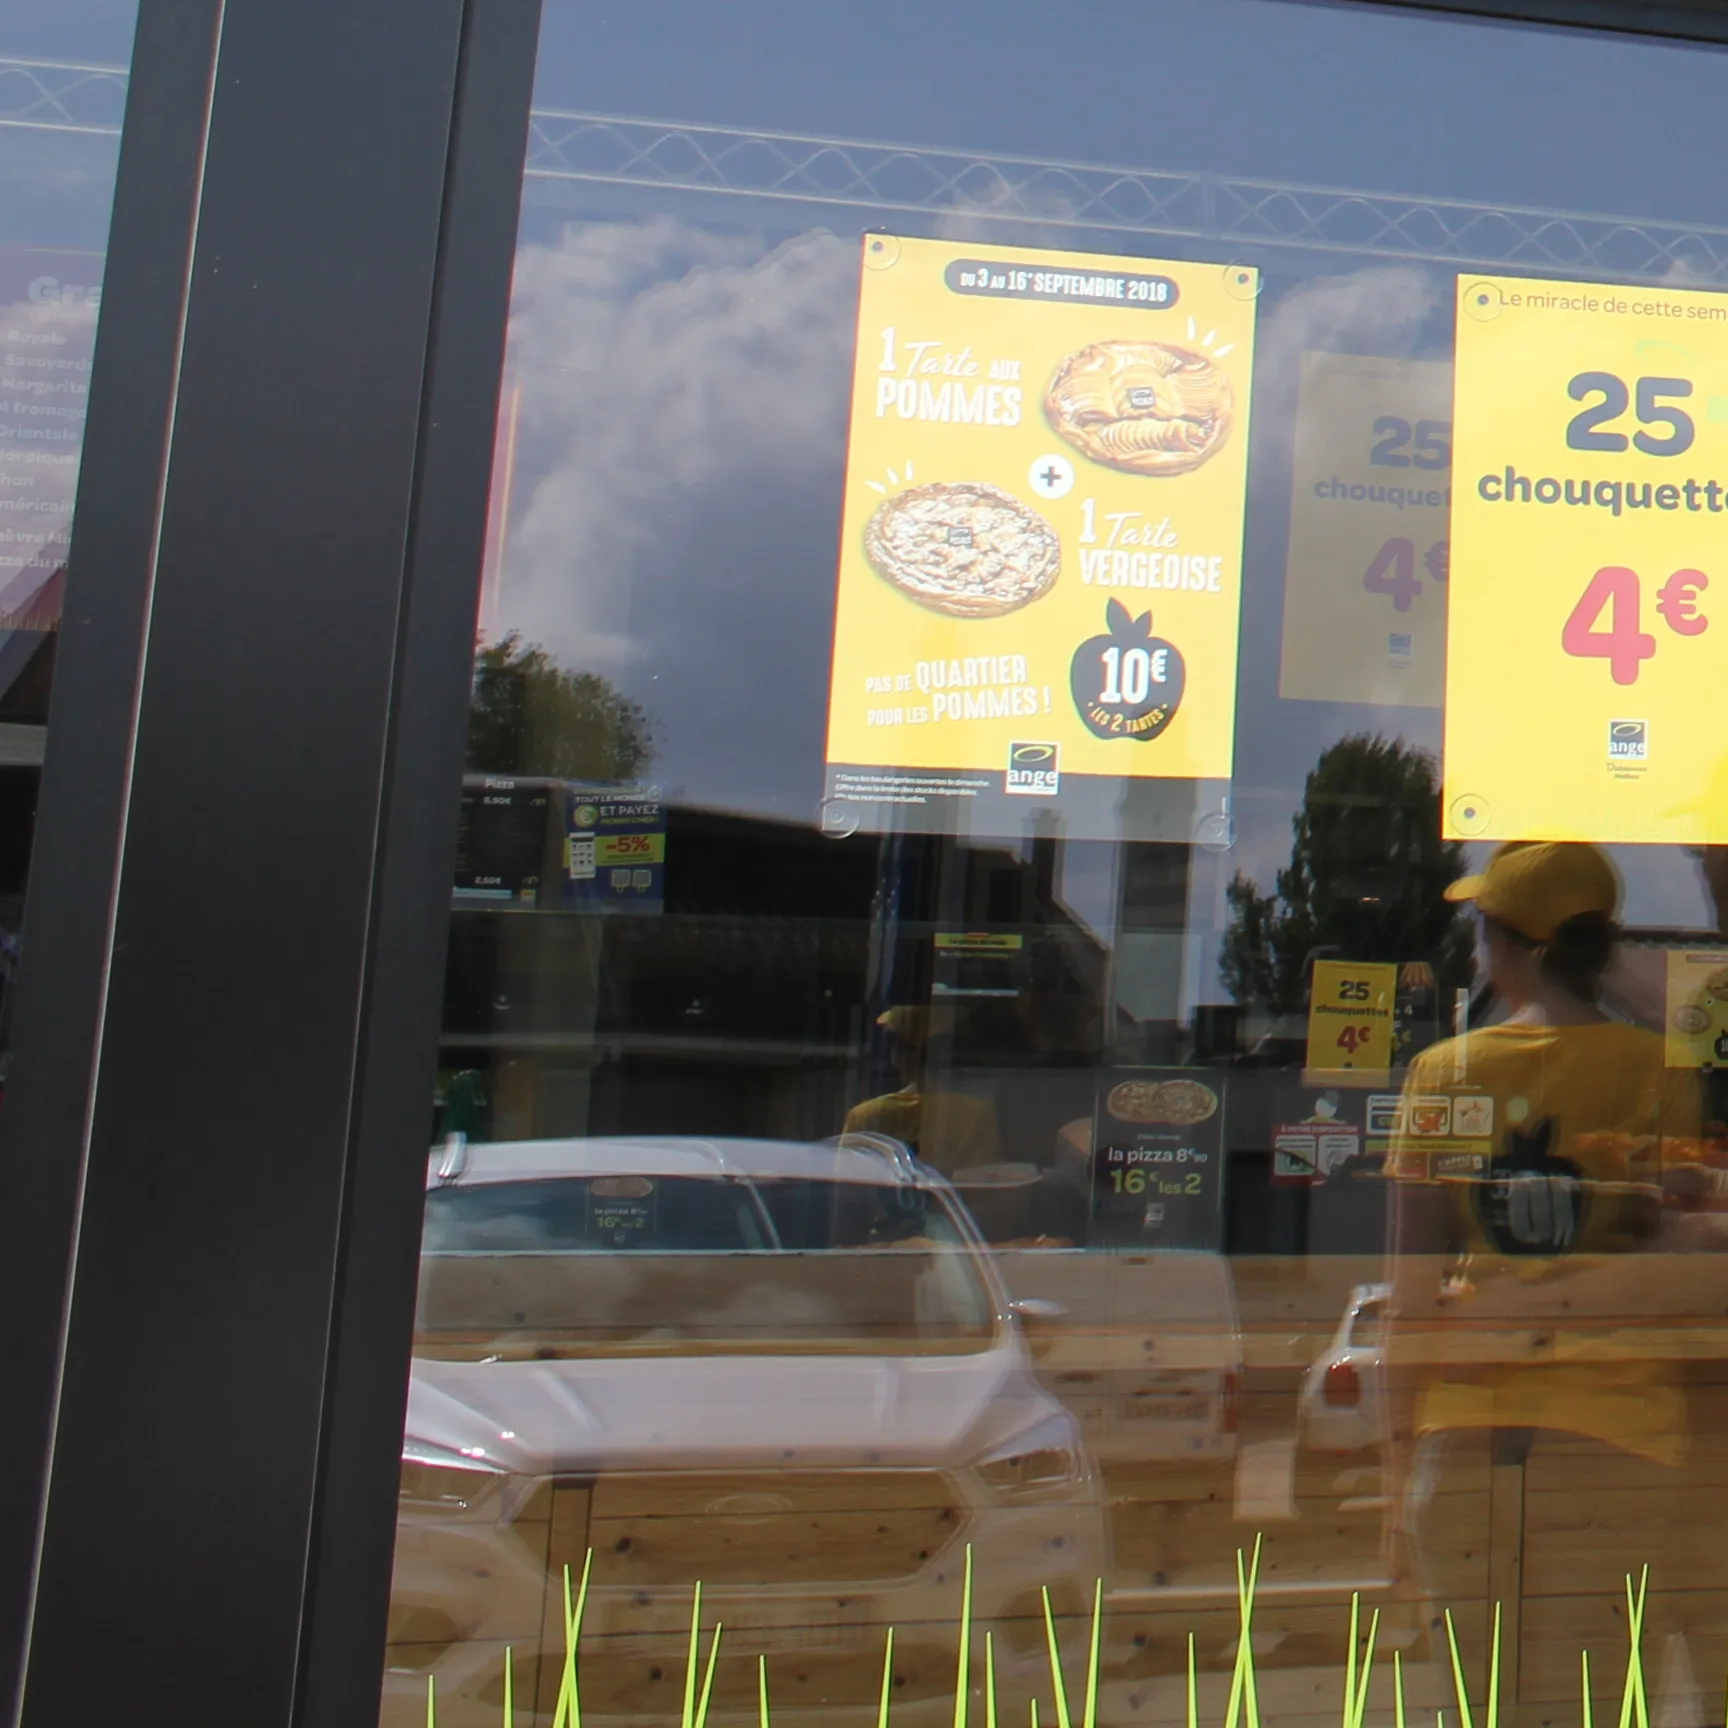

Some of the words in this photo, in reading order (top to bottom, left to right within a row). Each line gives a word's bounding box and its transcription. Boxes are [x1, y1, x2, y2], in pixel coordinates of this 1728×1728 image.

[977, 268, 989, 288] 3
[1034, 272, 1125, 301] SEPTEMBRE
[1127, 280, 1168, 303] 2018
[1499, 288, 1522, 308] Le
[1525, 290, 1599, 313] miracle
[1602, 294, 1628, 315] de
[1631, 296, 1683, 318] cette
[879, 327, 897, 373] 1
[905, 341, 980, 379] Tarte
[989, 359, 1021, 382] AUX
[876, 377, 1023, 427] POMMES
[1565, 370, 1696, 457] 25
[1079, 498, 1097, 544] 1
[1104, 511, 1179, 549] Tarte
[1078, 548, 1222, 593] VERGEOISE
[1561, 565, 1710, 686] 4€
[866, 675, 893, 693] PAS
[895, 673, 912, 692] DE
[915, 654, 1028, 694] QUARTIER
[1100, 646, 1168, 704] 10€
[868, 707, 904, 726] POUR
[907, 705, 928, 724] LES
[933, 687, 1039, 722] POMMES
[1091, 707, 1110, 731] LES
[1110, 713, 1122, 733] 2
[1124, 707, 1166, 734] TARTES
[1007, 768, 1058, 789] ange
[600, 805, 616, 816] ET
[619, 804, 660, 816] PAYEZ
[606, 836, 650, 853] -5%
[1338, 980, 1370, 1000] 25
[1336, 1025, 1371, 1053] 4€
[1108, 1147, 1123, 1161] la
[1127, 1147, 1173, 1164] pizza
[1159, 1180, 1182, 1194] les
[1185, 1172, 1202, 1194] 2
